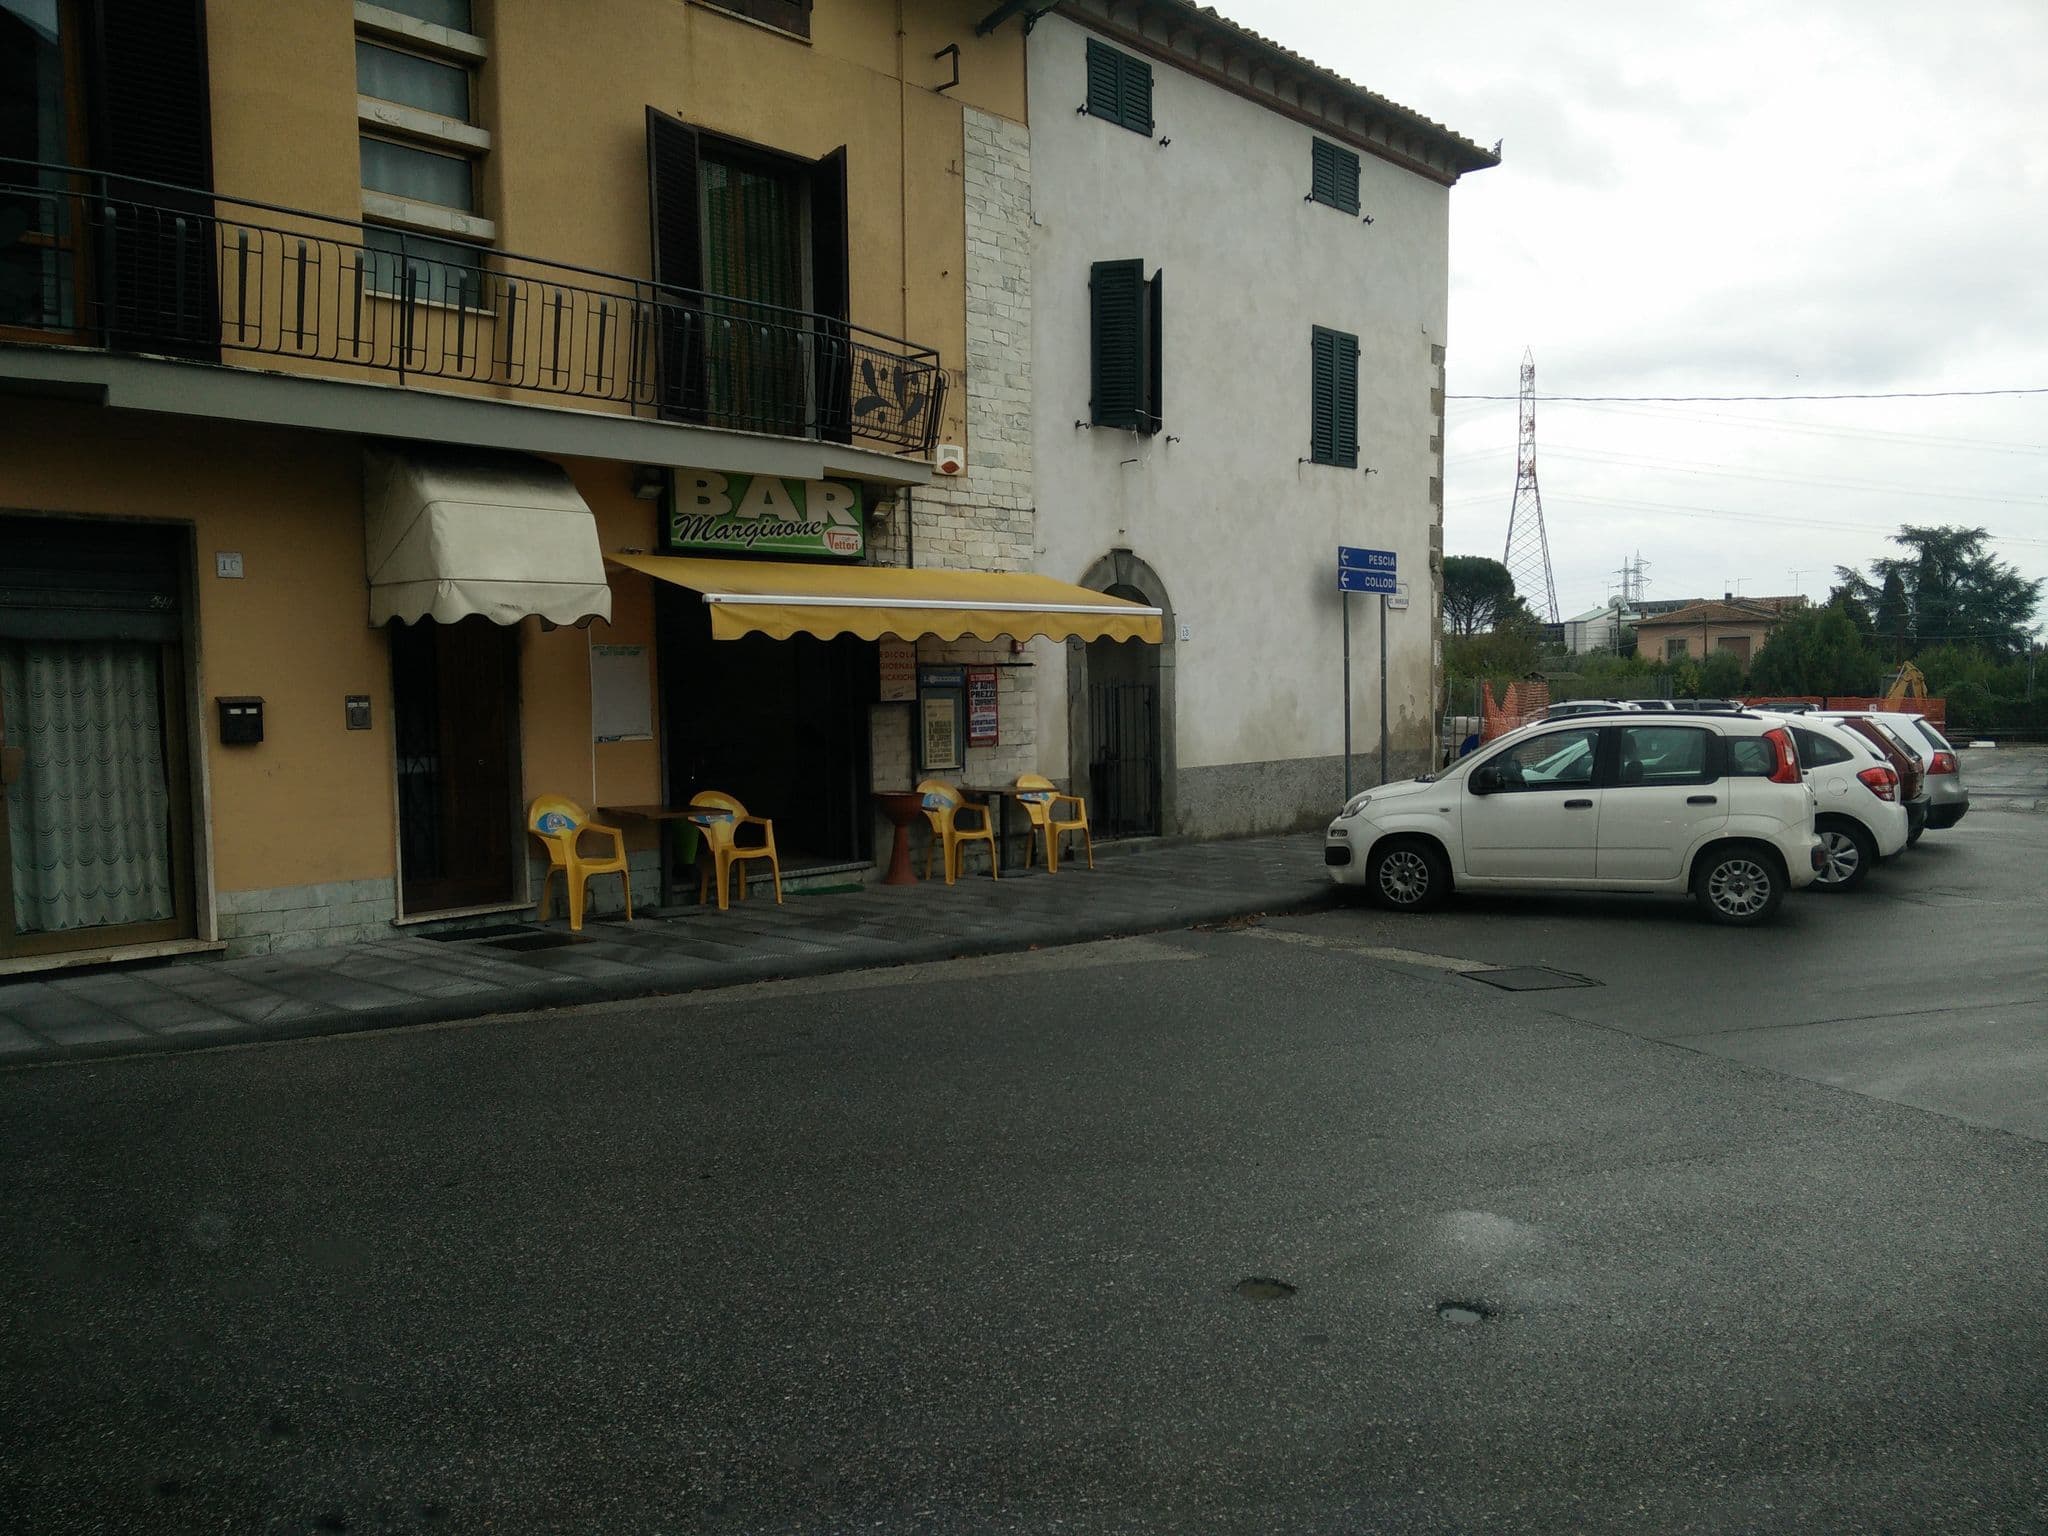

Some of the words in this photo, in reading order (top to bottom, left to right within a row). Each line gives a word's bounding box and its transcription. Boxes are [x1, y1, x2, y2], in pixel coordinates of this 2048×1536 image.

[674, 470, 859, 526] BAR
[674, 515, 823, 548] Marginone
[826, 531, 860, 551] Vettori
[1369, 555, 1395, 566] PESCIA
[1365, 577, 1396, 588] COLLODI
[970, 690, 996, 698] PREZZI
